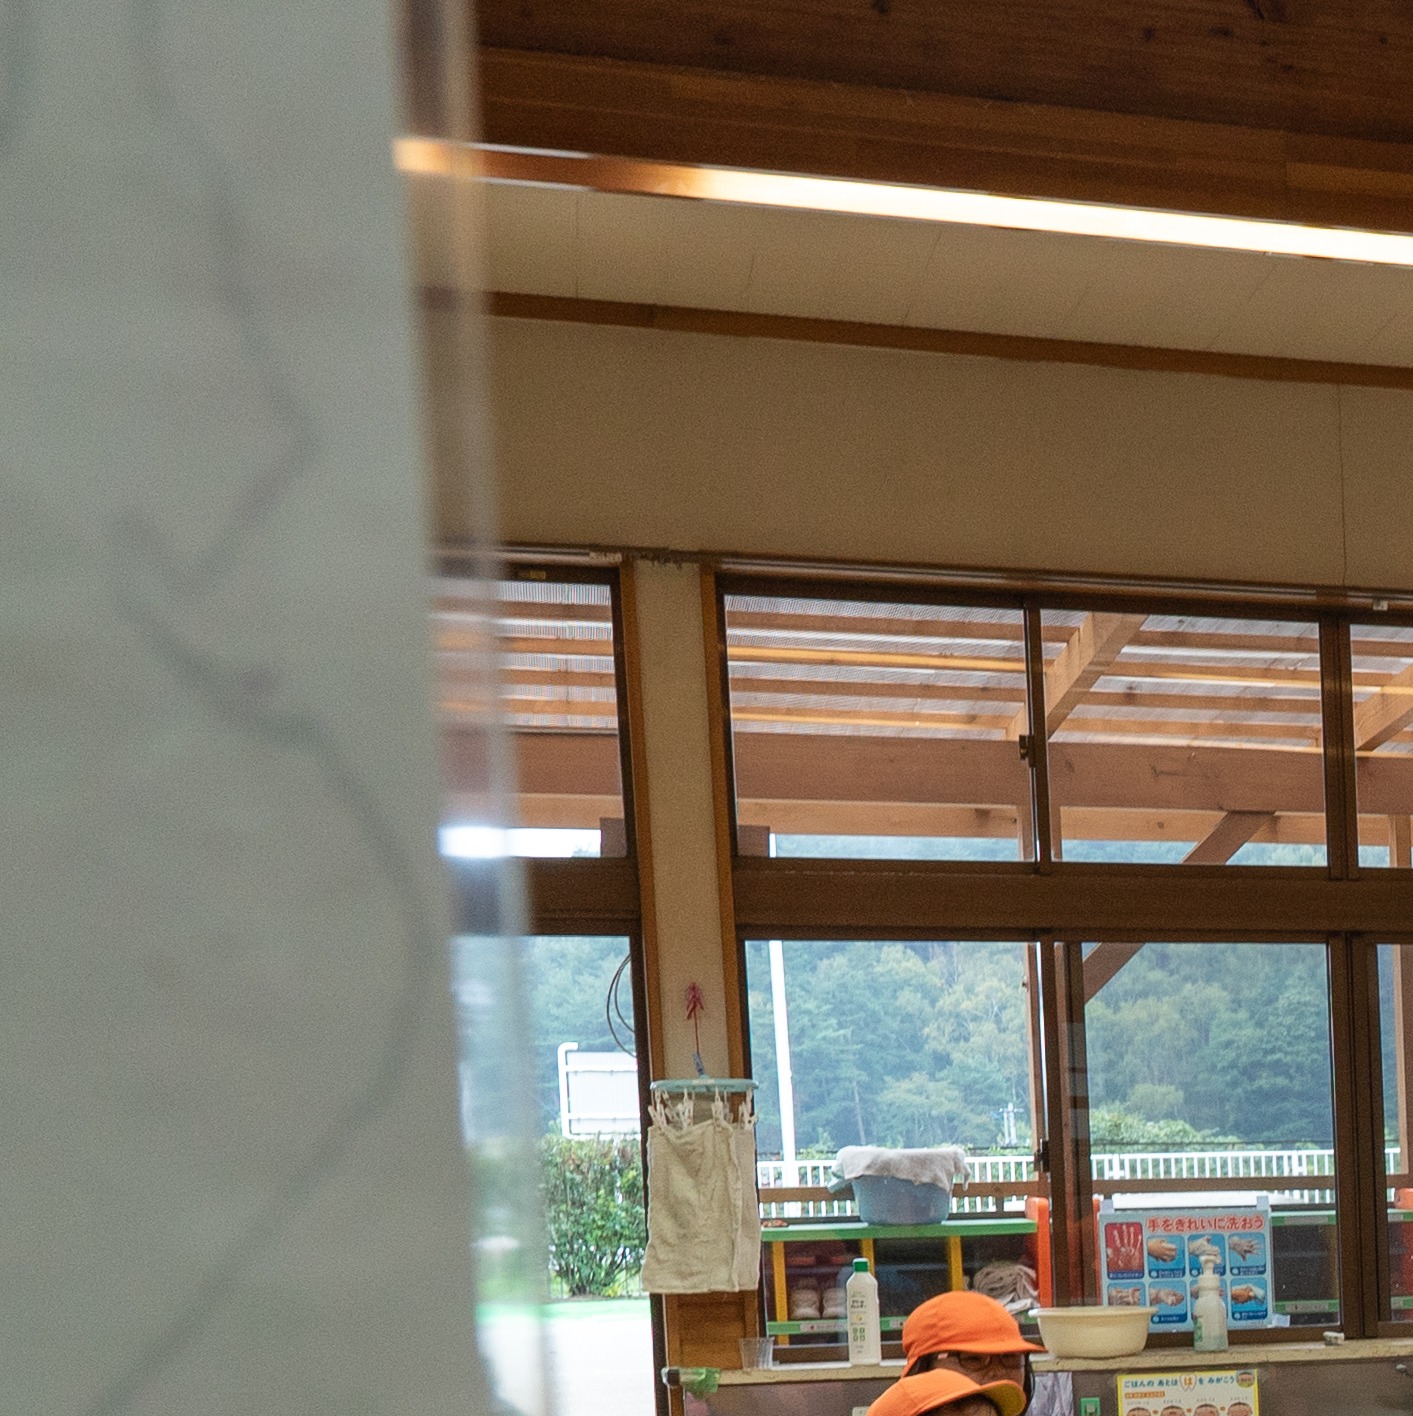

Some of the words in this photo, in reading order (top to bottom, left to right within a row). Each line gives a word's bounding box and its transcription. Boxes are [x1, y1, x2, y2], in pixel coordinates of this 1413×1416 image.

[1146, 1214, 1265, 1233] 手をきれいに洗おう
[1124, 1379, 1155, 1388] ごはんの
[1157, 1378, 1179, 1387] あとは
[1183, 1377, 1193, 1386] は
[1198, 1377, 1205, 1385] を
[1207, 1375, 1236, 1385] みがこう
